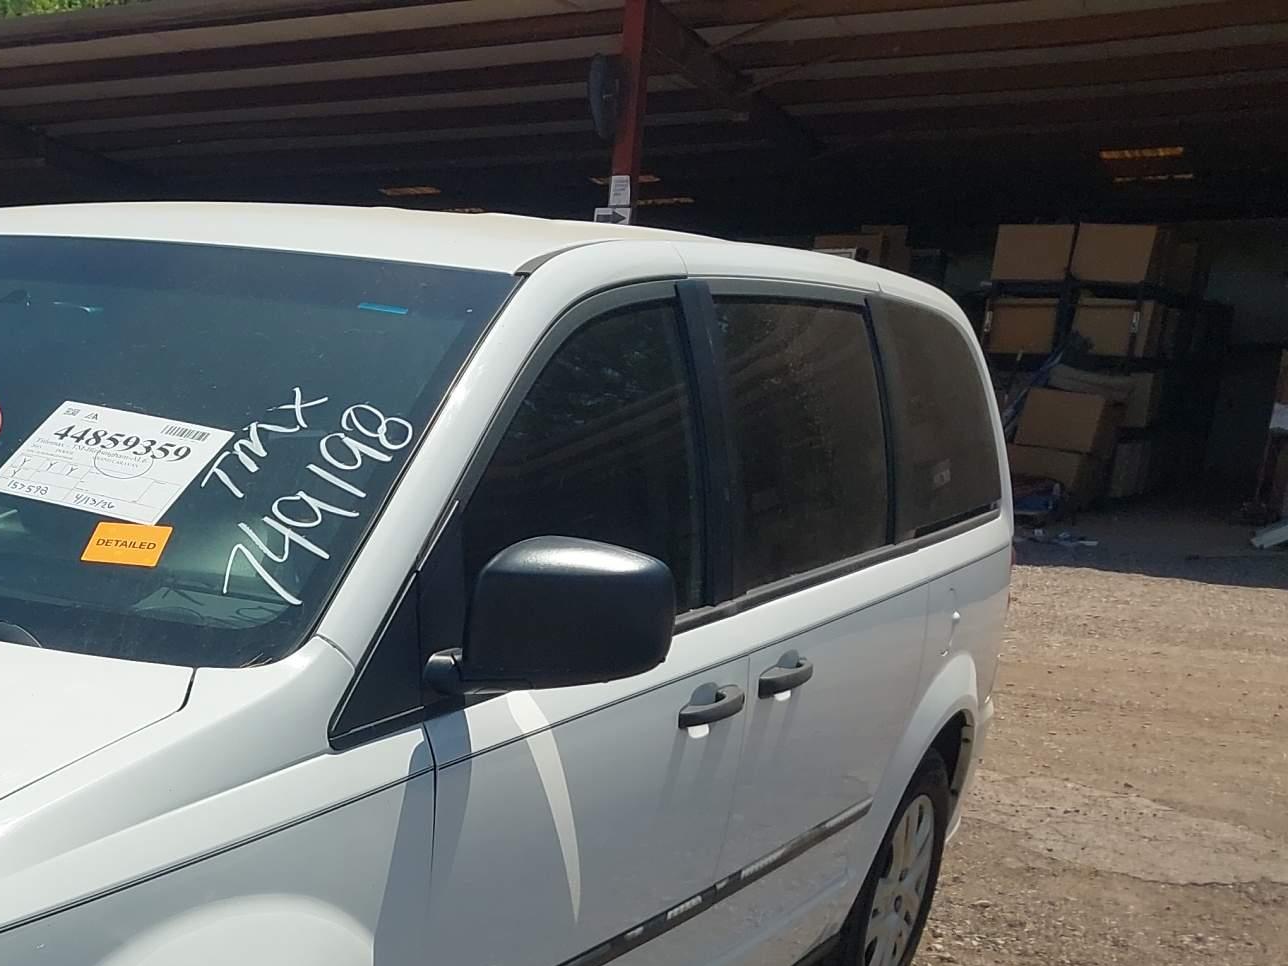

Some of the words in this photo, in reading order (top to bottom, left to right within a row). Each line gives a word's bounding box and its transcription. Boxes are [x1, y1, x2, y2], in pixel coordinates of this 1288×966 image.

[53, 424, 192, 463] 44859359
[74, 493, 115, 510] 4/13/26
[222, 402, 414, 606] 749198
[96, 538, 157, 550] DETAILED
